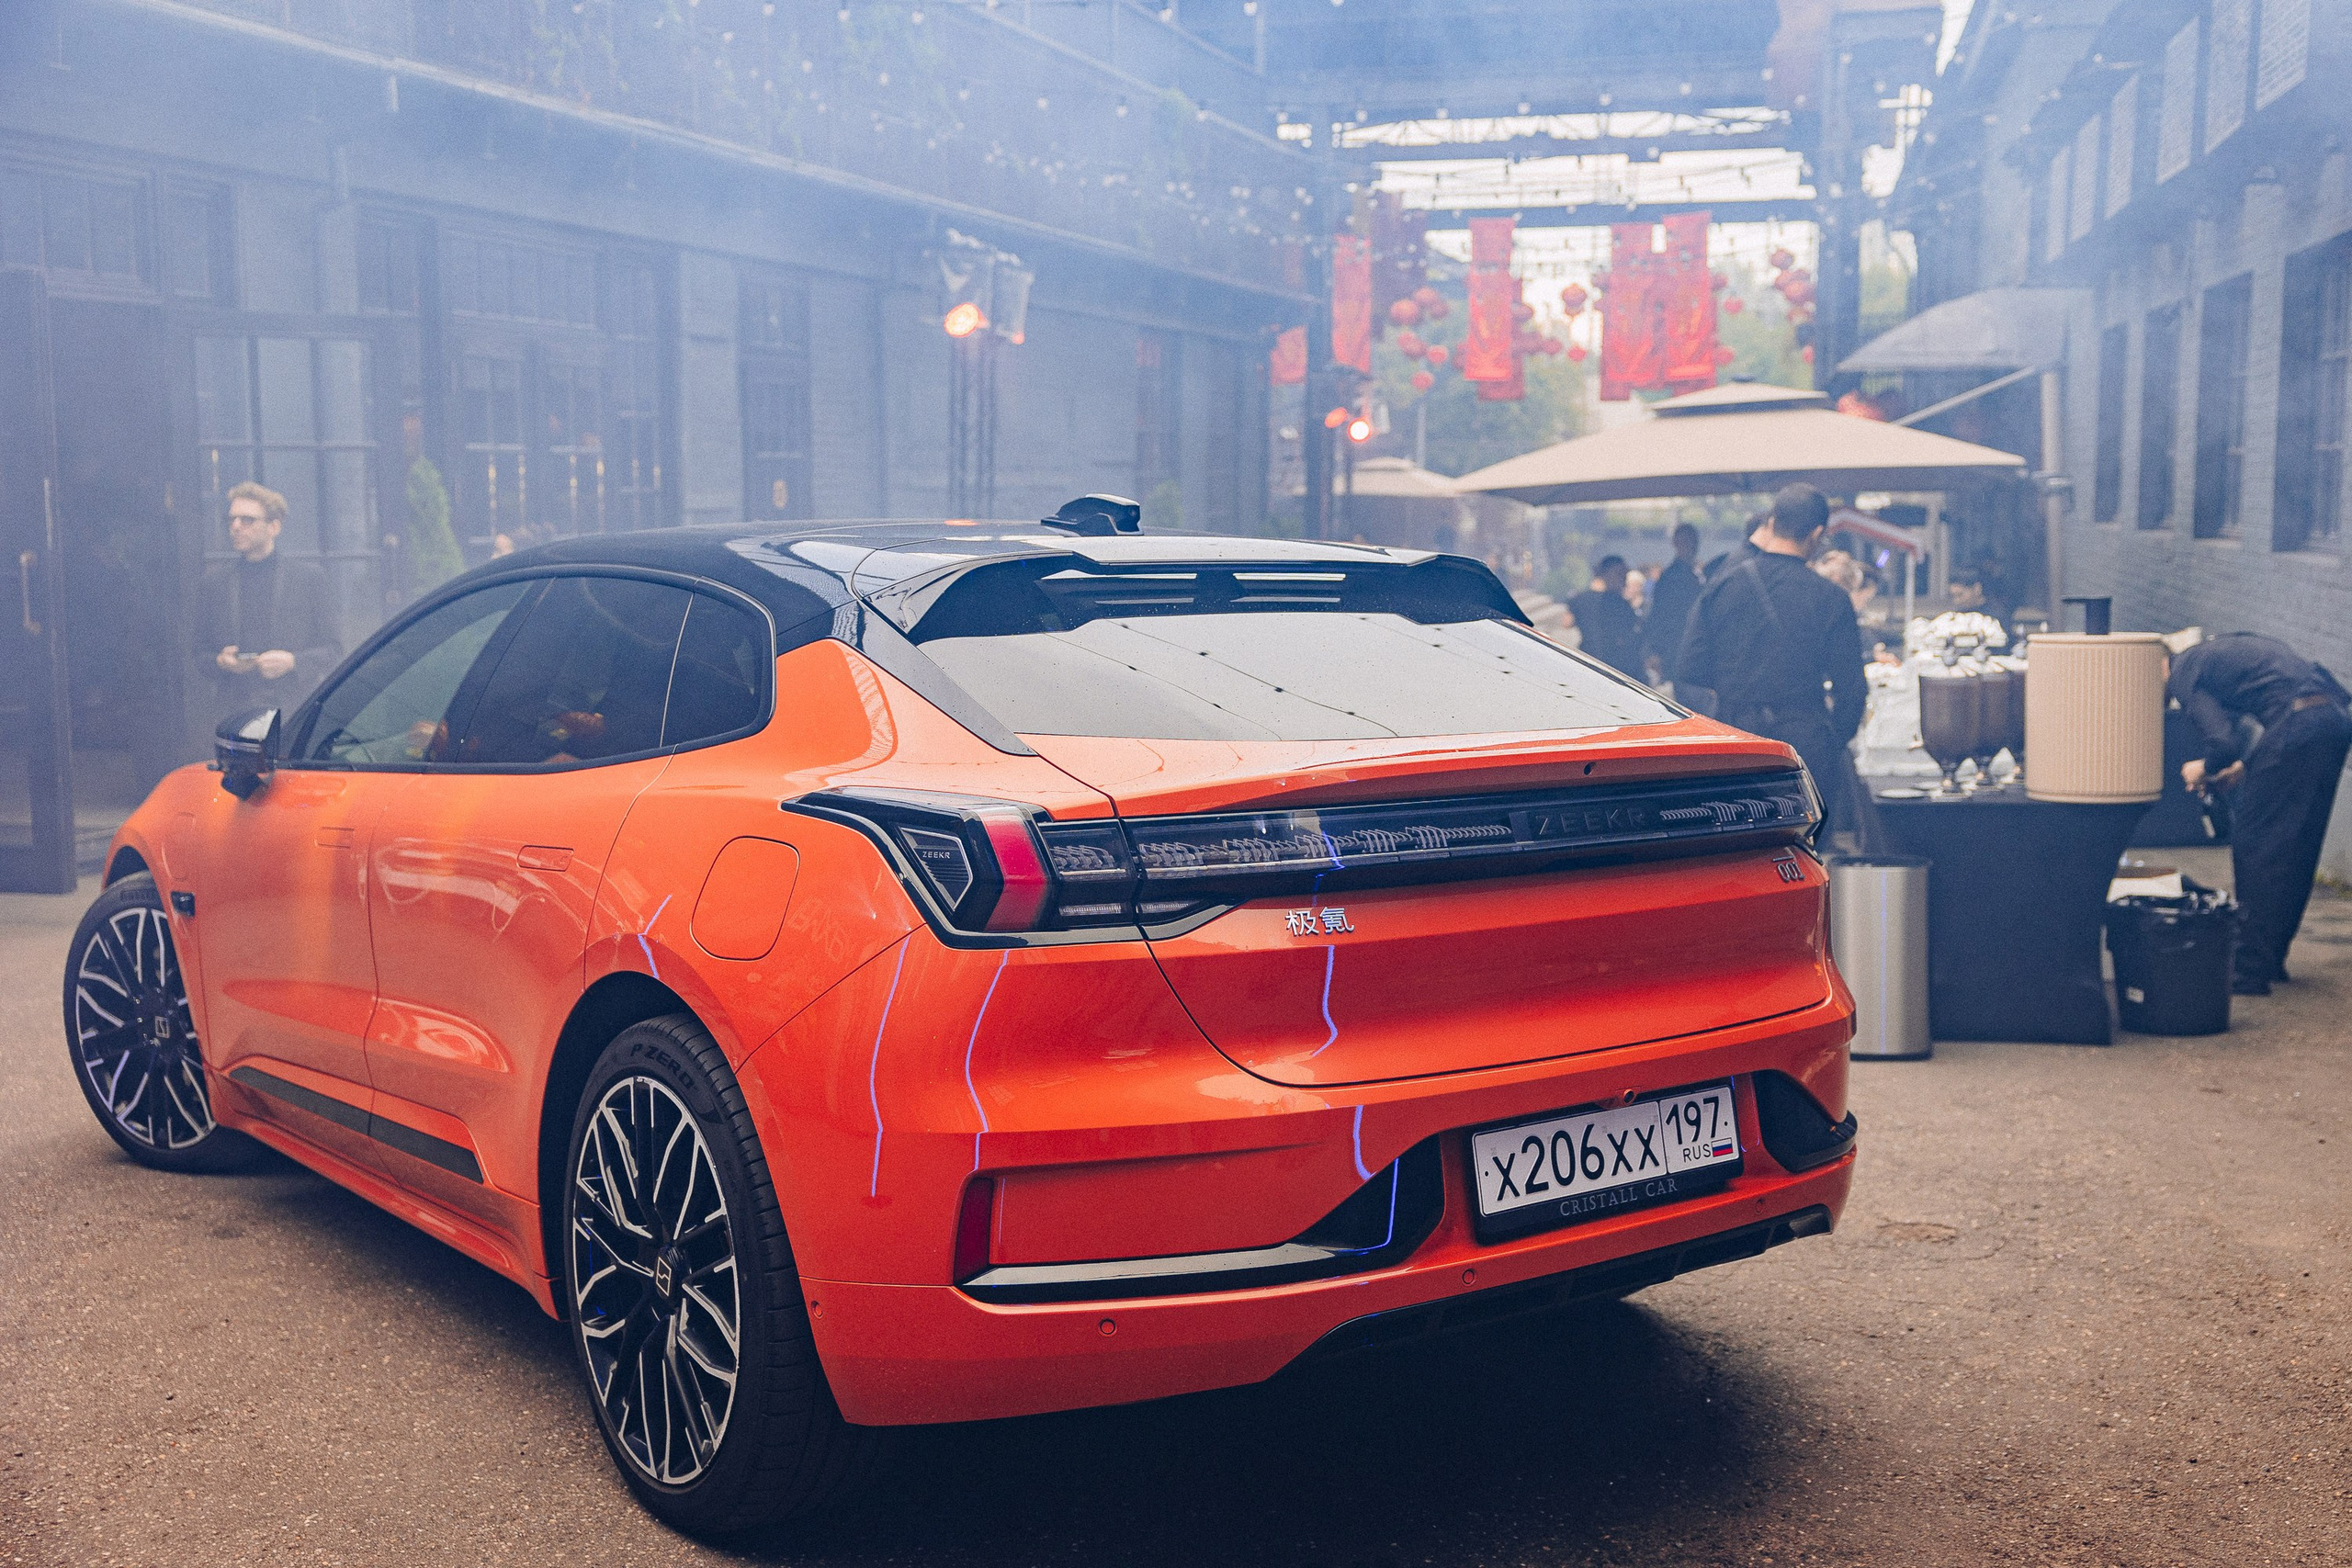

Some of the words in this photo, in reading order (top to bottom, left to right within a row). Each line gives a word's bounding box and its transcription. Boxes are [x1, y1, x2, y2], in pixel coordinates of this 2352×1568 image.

[1535, 807, 1645, 836] ZEEKR
[922, 850, 951, 860] ZEEKR
[1776, 862, 1804, 882] 001
[1284, 906, 1355, 936] 极氪
[630, 1043, 644, 1057] P
[646, 1045, 695, 1090] ZERO
[1665, 1096, 1721, 1145] 197
[1682, 1144, 1712, 1163] RUS
[1560, 1186, 1638, 1217] CRISTALL
[1645, 1179, 1678, 1197] CAR
